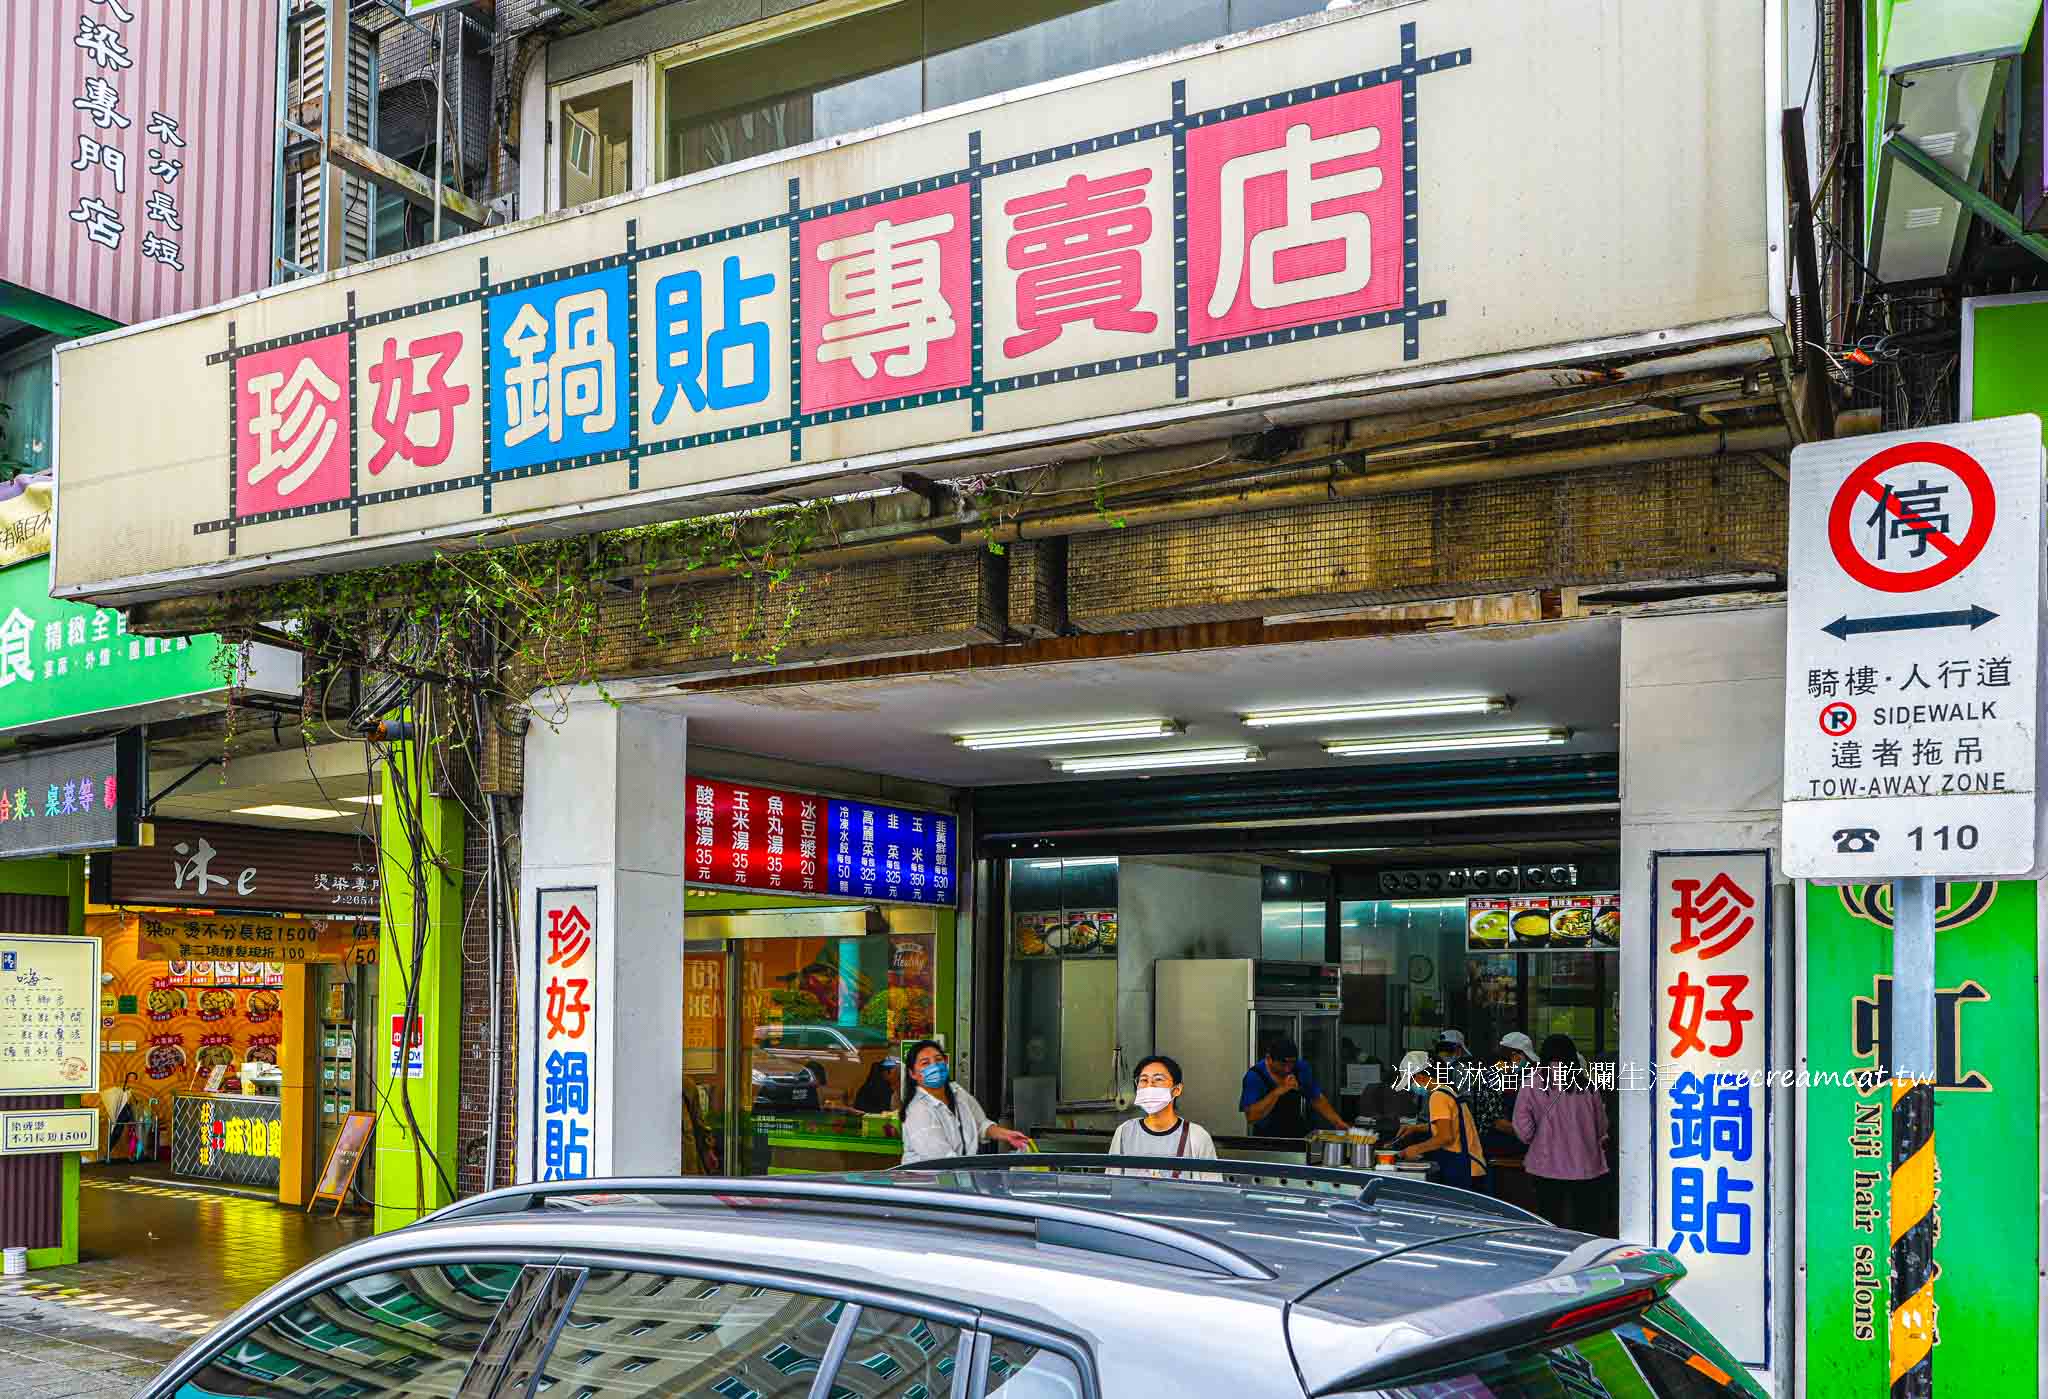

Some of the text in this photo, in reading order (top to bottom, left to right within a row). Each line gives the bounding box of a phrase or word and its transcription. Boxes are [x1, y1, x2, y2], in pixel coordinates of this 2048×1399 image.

[142, 111, 186, 271] 不分長短
[247, 122, 1383, 495] 珍好鍋貼專賣店
[1866, 480, 1951, 560] 停
[1831, 737, 1983, 769] 違者拖吊
[1873, 701, 1997, 726] SIDEWALK
[1809, 773, 2006, 797] TOW-AWAY ZONE
[1907, 824, 1979, 851] 110
[393, 1050, 421, 1061] SOM
[544, 904, 592, 1182] 珍好鍋貼
[1667, 872, 1755, 1257] 珍好鍋貼
[1850, 1102, 1881, 1340] Niji hair salons
